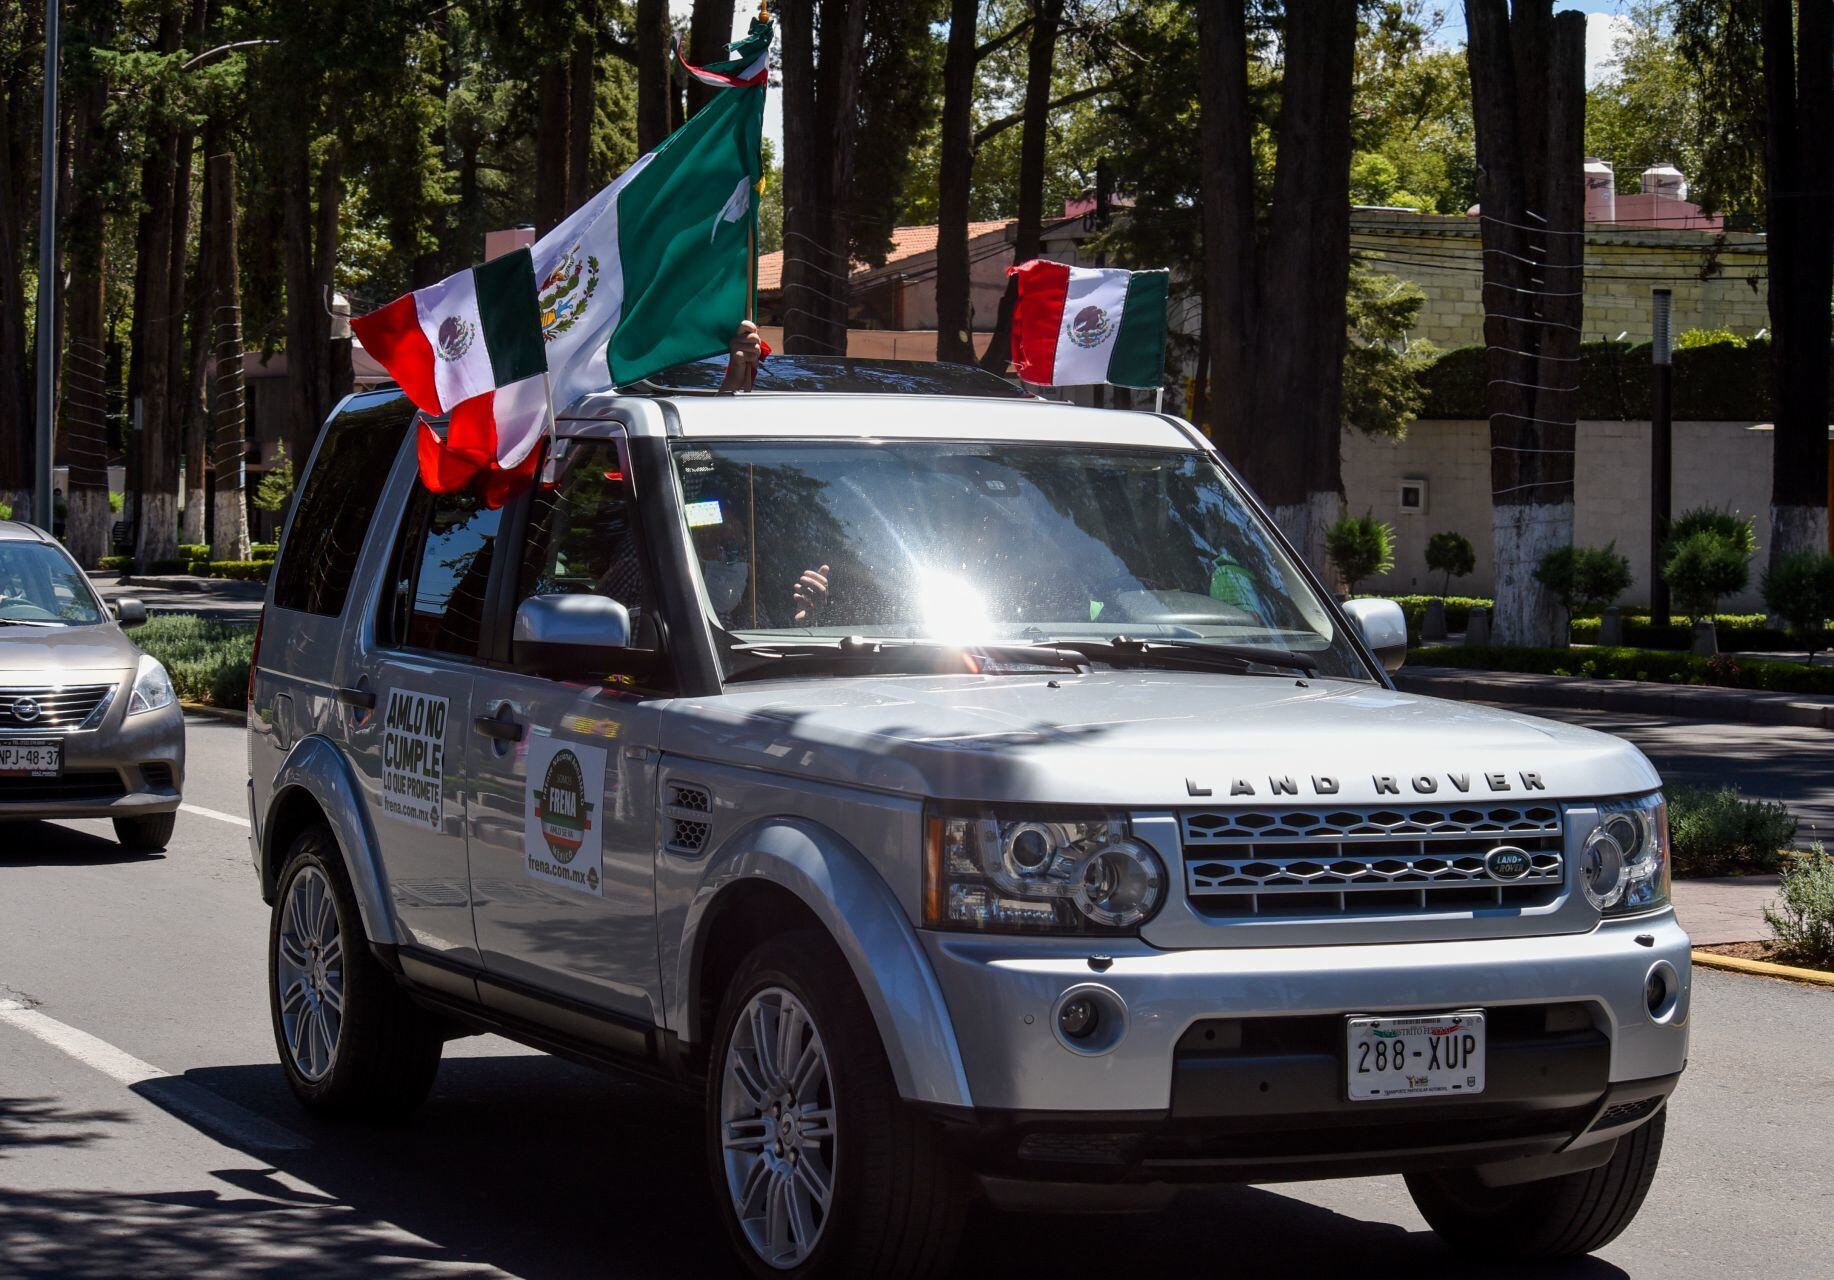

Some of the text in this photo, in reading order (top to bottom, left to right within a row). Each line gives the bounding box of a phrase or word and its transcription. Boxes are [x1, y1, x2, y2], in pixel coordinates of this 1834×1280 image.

[387, 692, 446, 740] AMLO NO
[384, 732, 442, 780] CUMPLE
[383, 769, 440, 804] LO QUE PROMETE
[1185, 770, 1546, 797] LAND ROVER
[384, 796, 429, 823] frena.com.mx
[549, 787, 577, 818] FRENA
[528, 853, 586, 885] frena.com.mx
[1497, 855, 1518, 864] LAND
[1499, 863, 1524, 873] ROVER
[1358, 1034, 1476, 1074] 288-XUP
